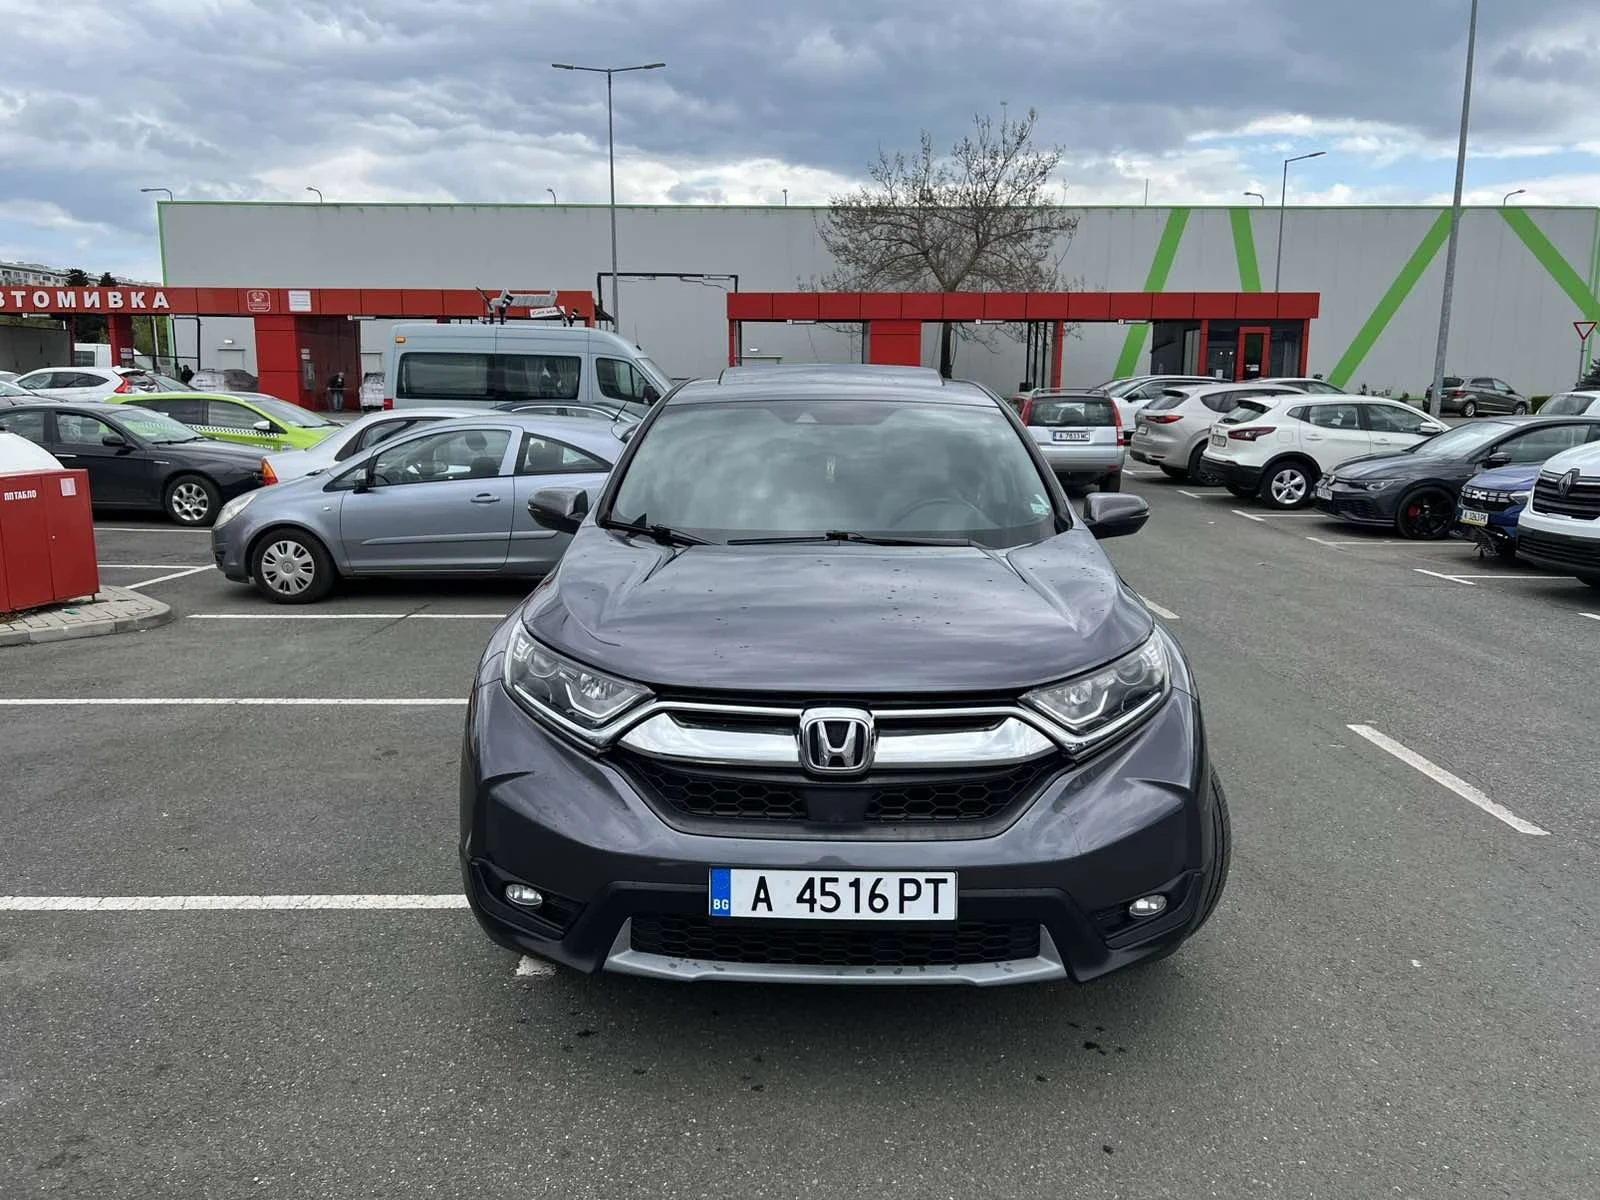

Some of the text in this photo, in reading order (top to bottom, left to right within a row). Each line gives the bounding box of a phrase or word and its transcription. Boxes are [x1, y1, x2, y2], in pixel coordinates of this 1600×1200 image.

[14, 489, 37, 500] ТАБЛО
[751, 875, 774, 912] A
[713, 899, 729, 910] BG
